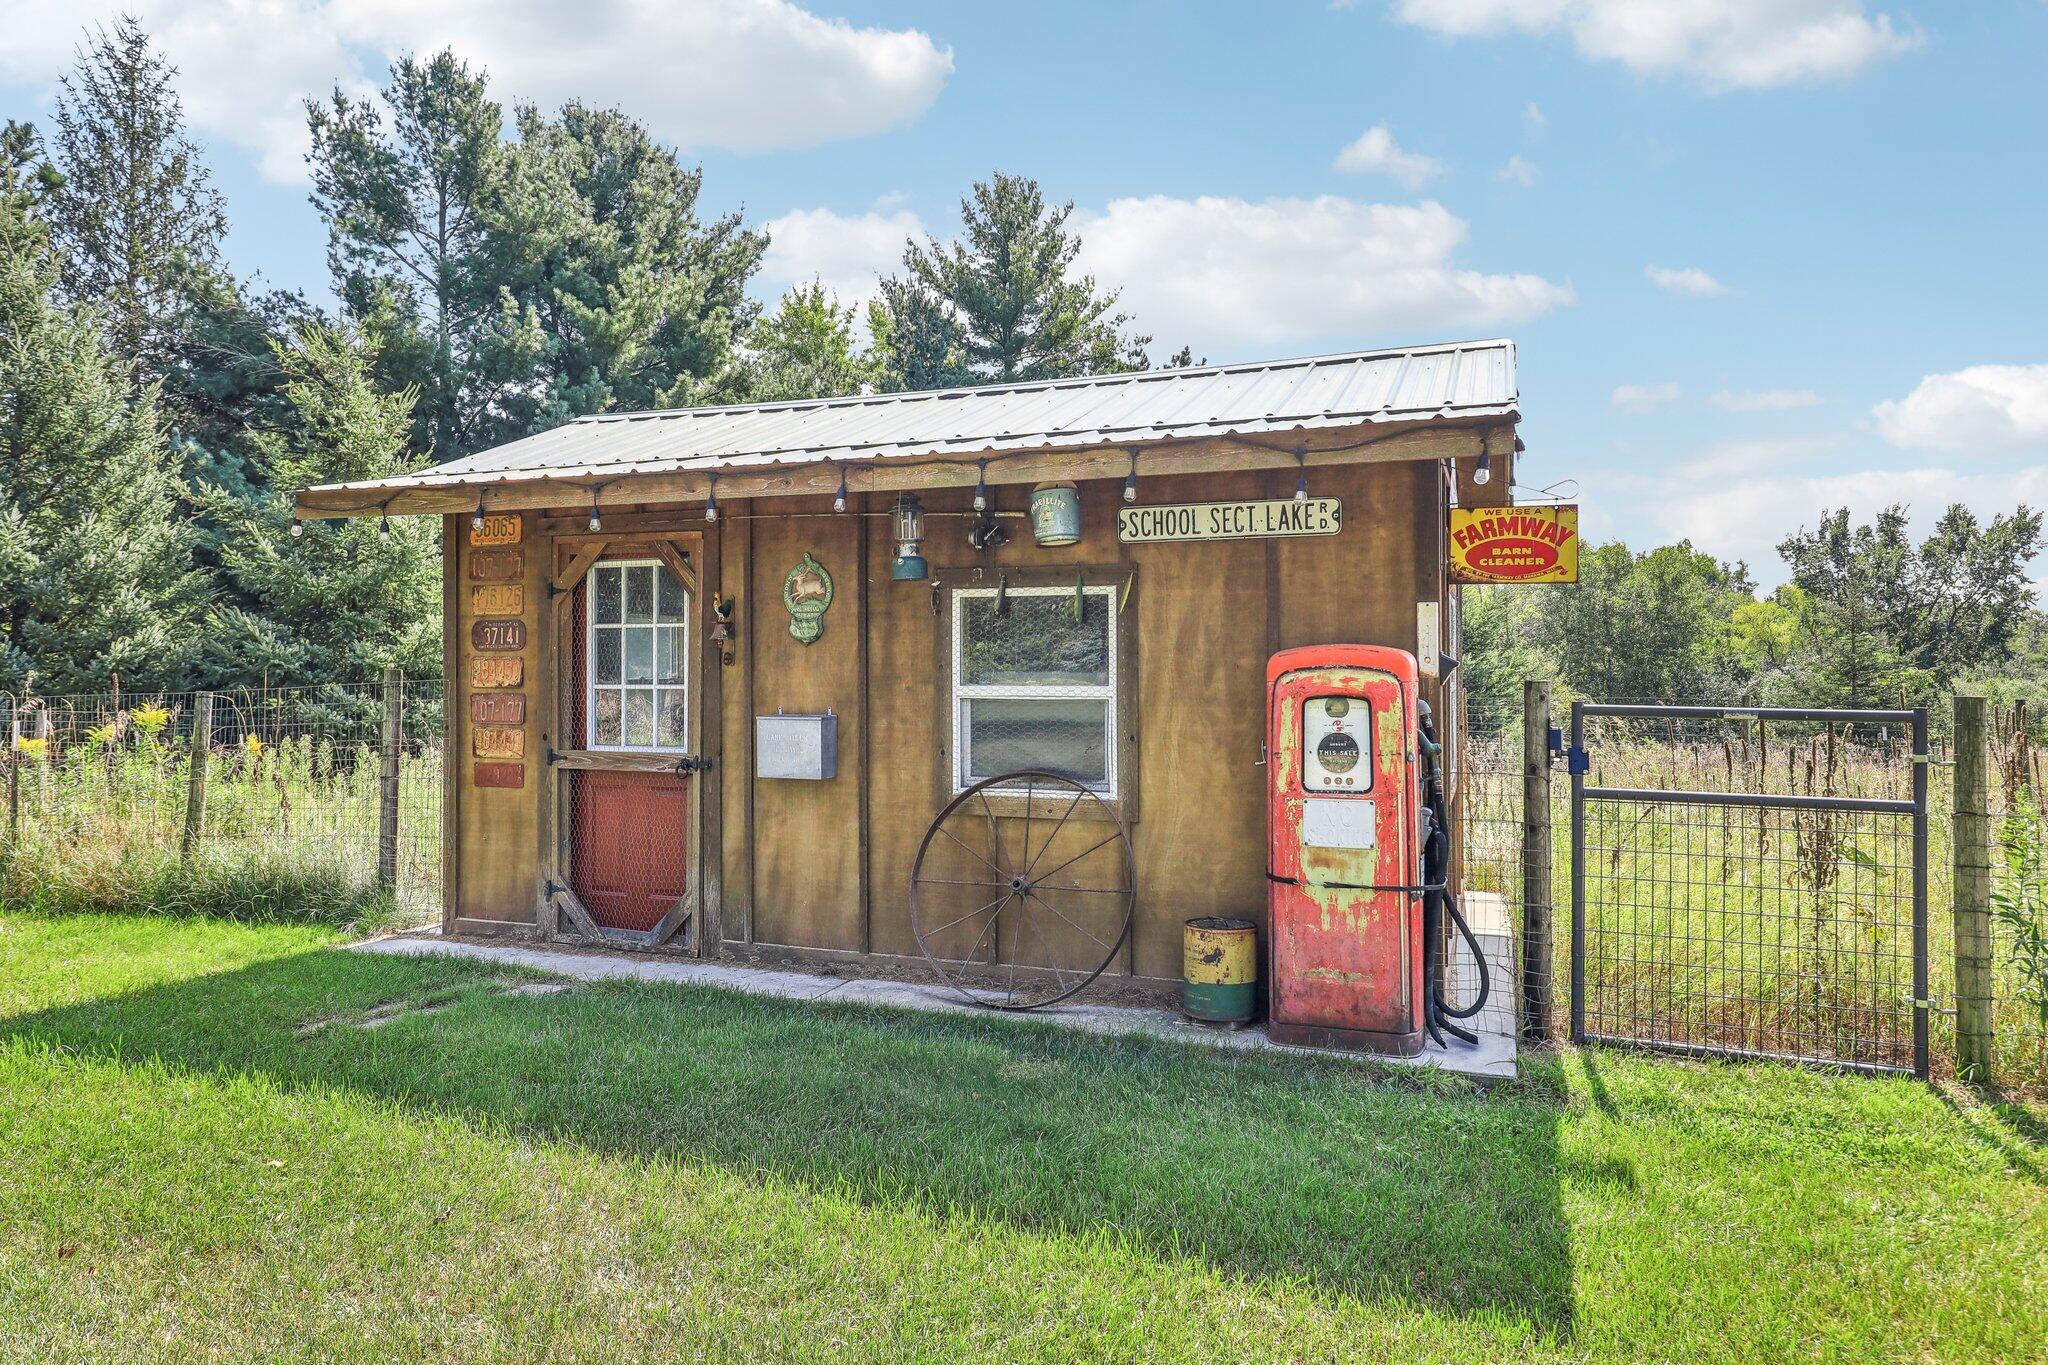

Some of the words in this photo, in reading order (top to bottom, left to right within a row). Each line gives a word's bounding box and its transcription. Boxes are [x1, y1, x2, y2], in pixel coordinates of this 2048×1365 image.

[1506, 508, 1530, 516] USE
[1128, 508, 1201, 538] SCHOOL
[1210, 505, 1258, 534] SECT.
[1266, 502, 1315, 531] LAKE
[1452, 516, 1575, 550] FARMWAY
[1492, 547, 1532, 556] BARN
[1479, 557, 1545, 566] CLEANER
[484, 627, 519, 645] 37141
